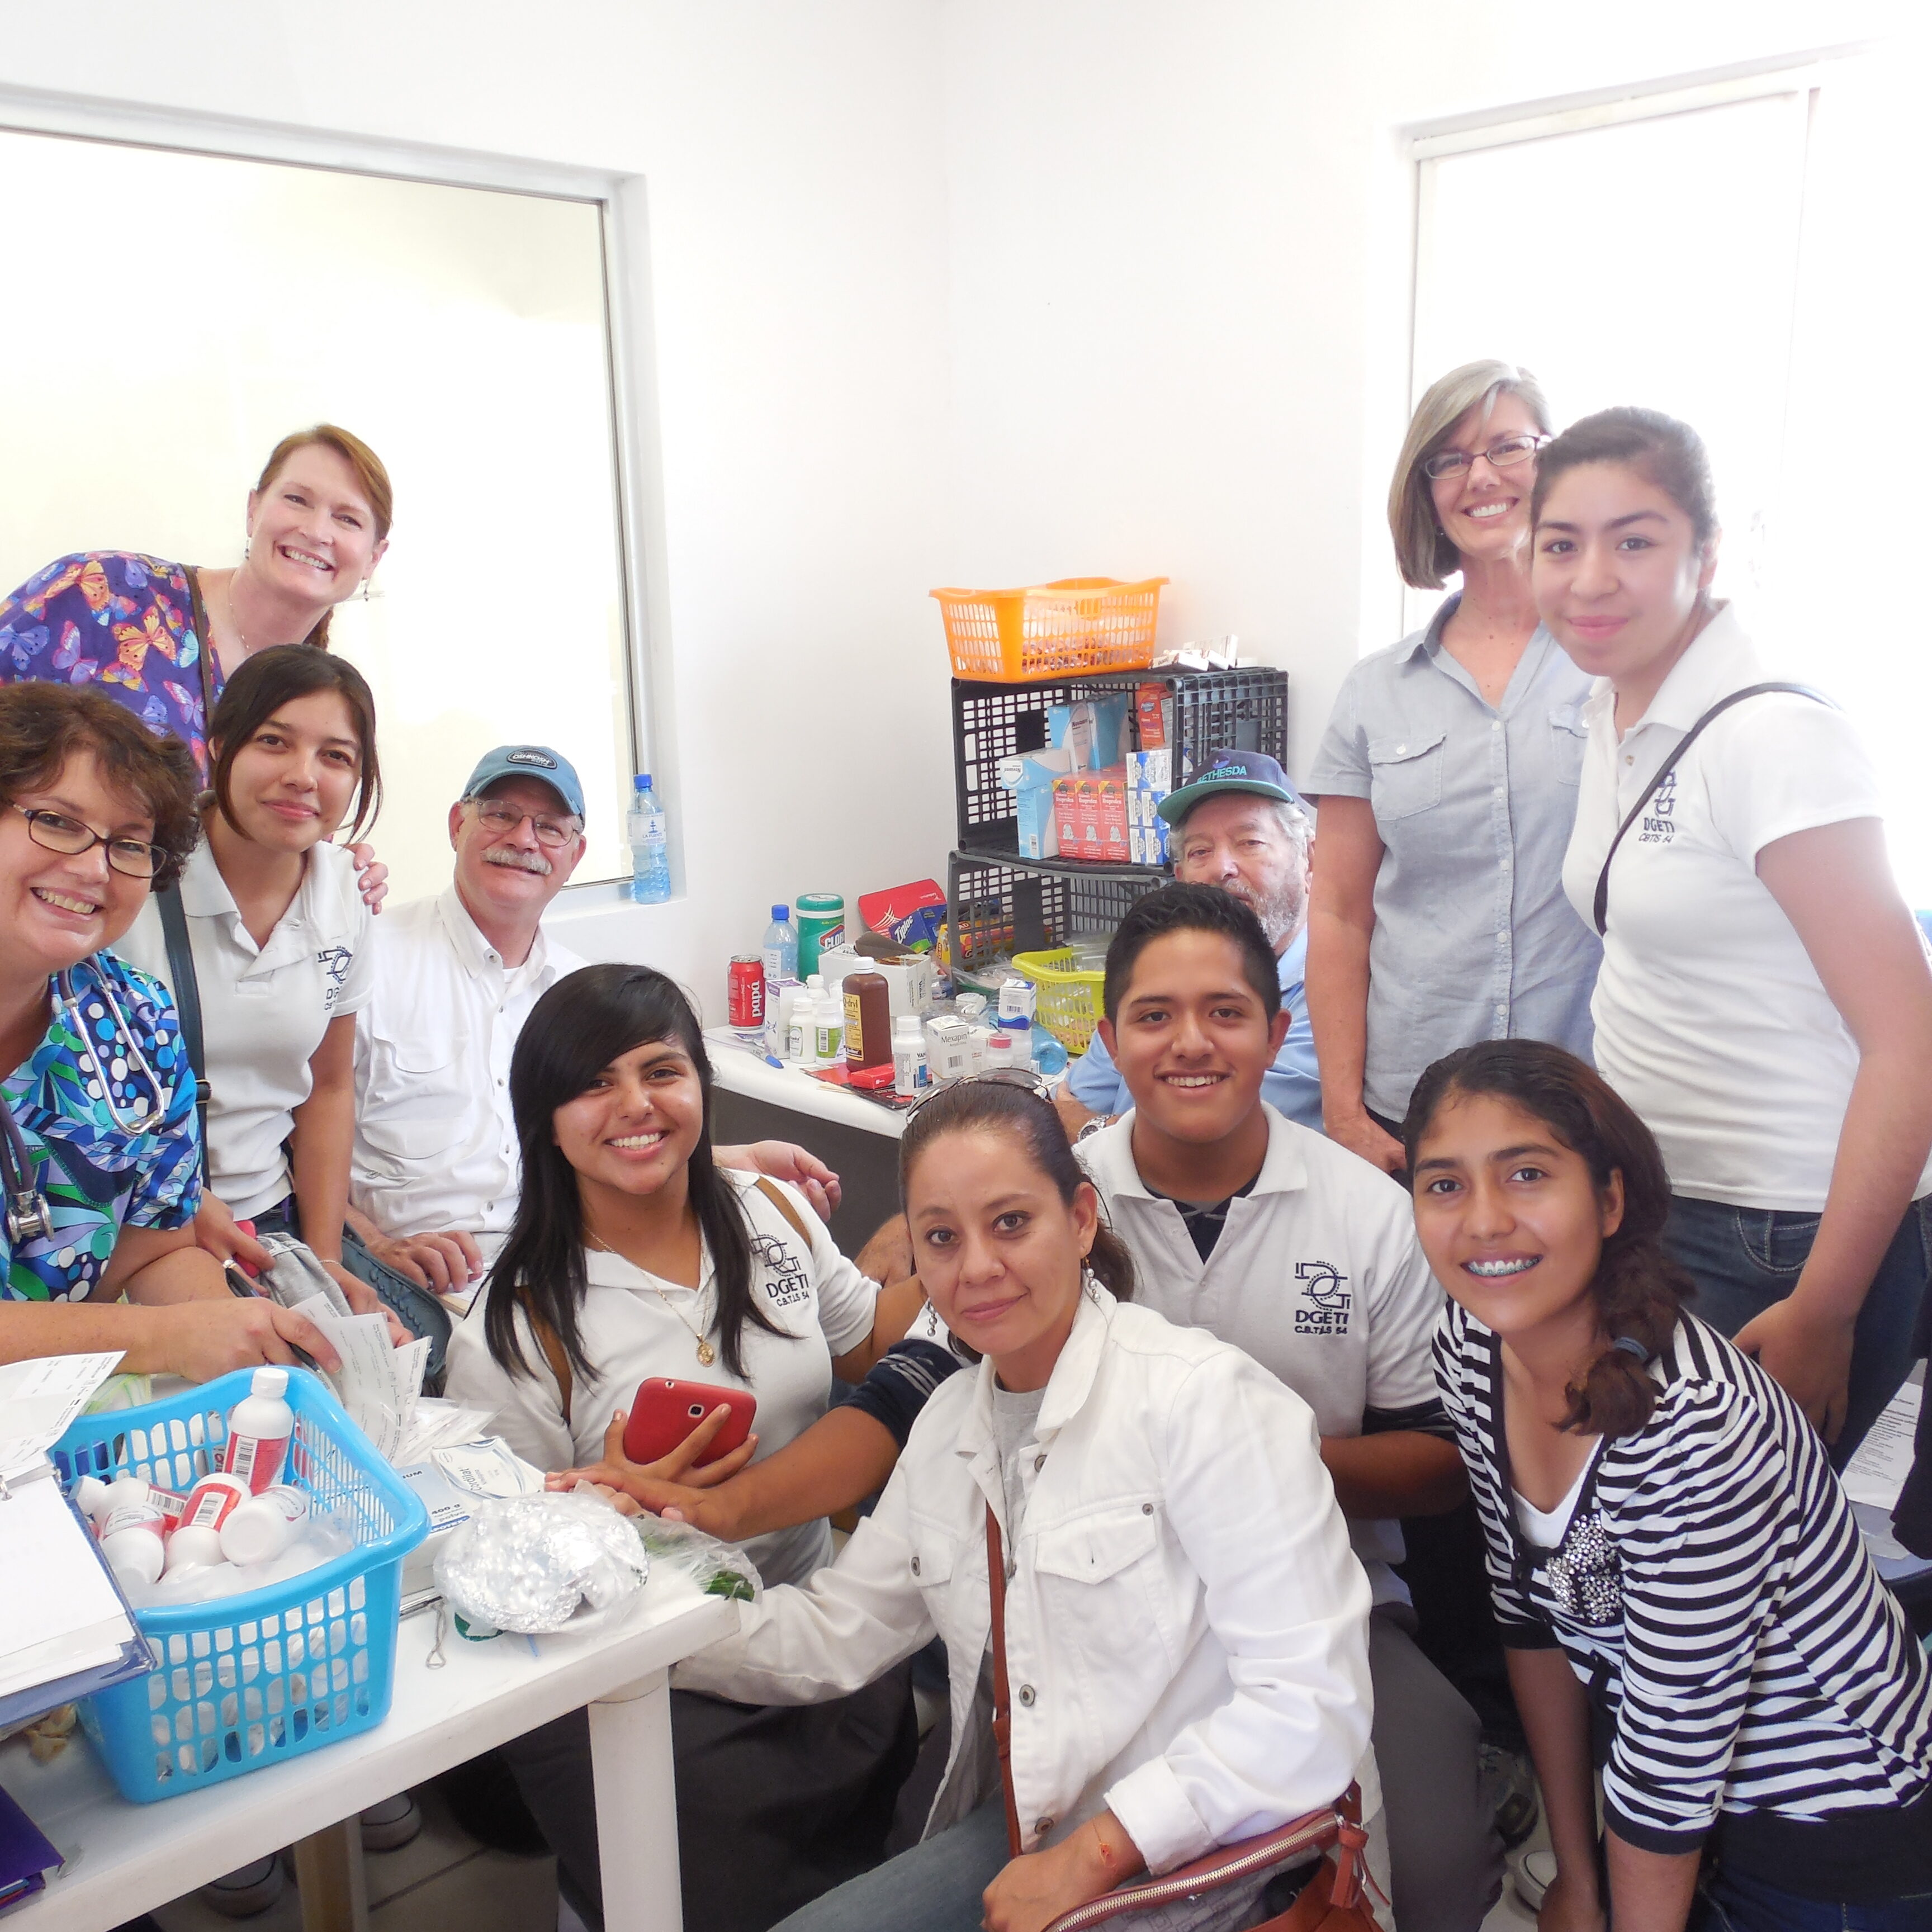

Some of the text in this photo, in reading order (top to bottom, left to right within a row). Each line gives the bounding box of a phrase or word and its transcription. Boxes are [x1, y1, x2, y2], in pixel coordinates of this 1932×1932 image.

[1644, 817, 1675, 832] DGETI
[894, 916, 913, 945] Ziploc
[747, 981, 763, 1017] papá
[941, 1034, 967, 1043] Mexapin
[766, 1273, 809, 1298] DGETI
[1295, 1310, 1349, 1324] DGETI
[432, 1506, 451, 1514] 400
